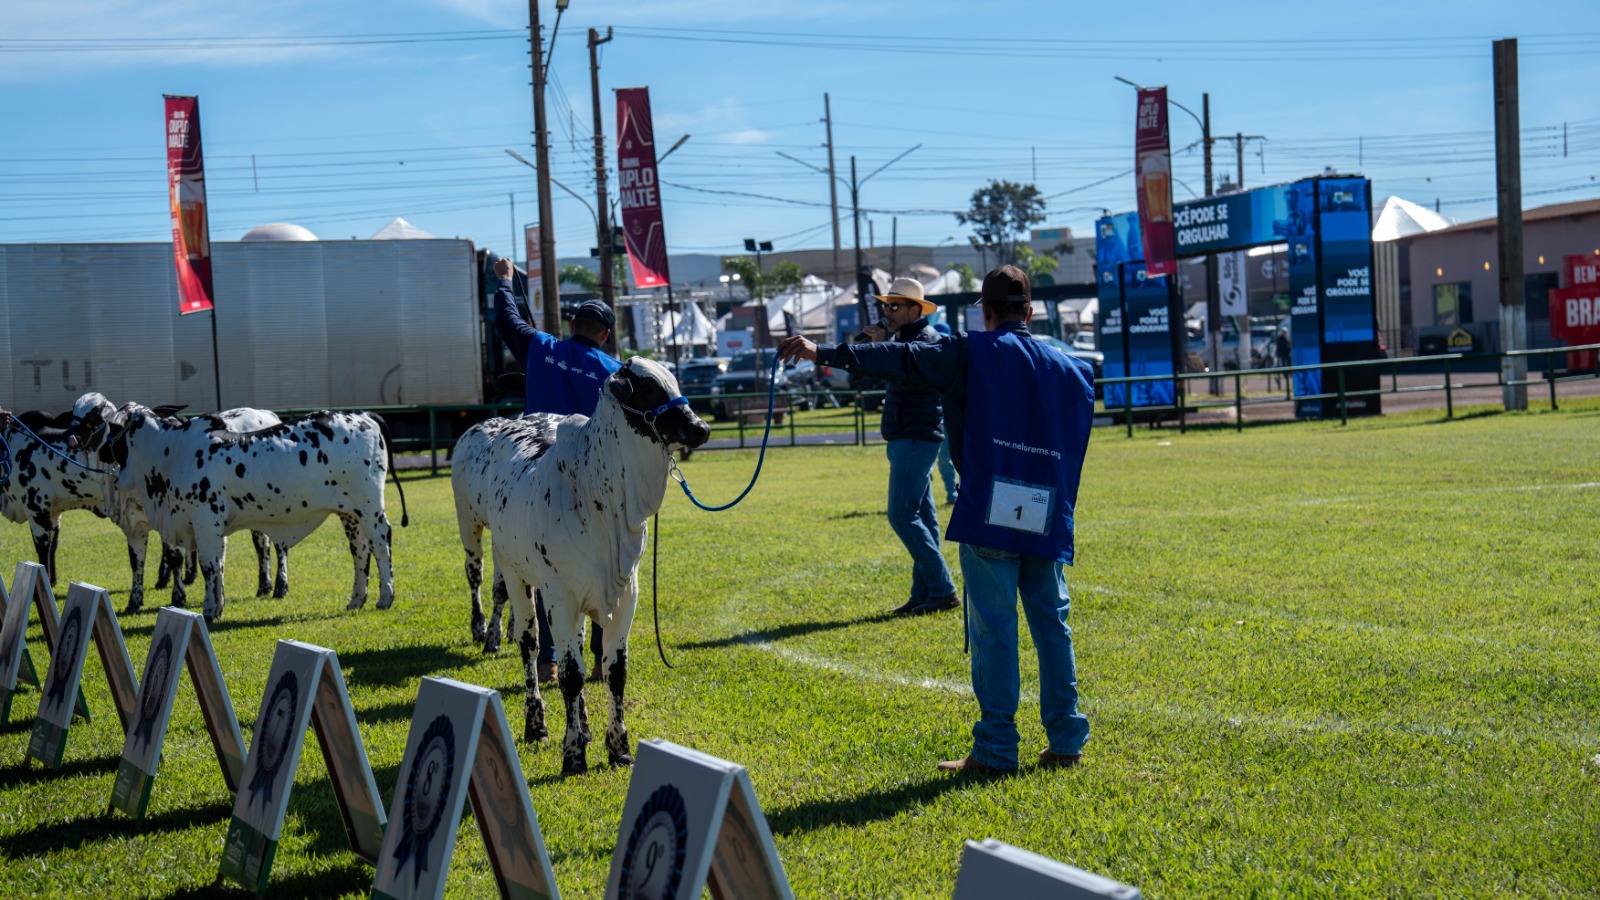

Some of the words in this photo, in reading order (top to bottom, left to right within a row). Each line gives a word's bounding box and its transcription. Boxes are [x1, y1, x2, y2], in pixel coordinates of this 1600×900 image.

[1174, 205, 1190, 228] OCÊ
[1190, 206, 1215, 224] PODE
[1217, 203, 1229, 220] SE
[1178, 223, 1229, 245] ORGULHAR
[993, 438, 1061, 460] www.nelorems.org
[1014, 506, 1023, 521] 1
